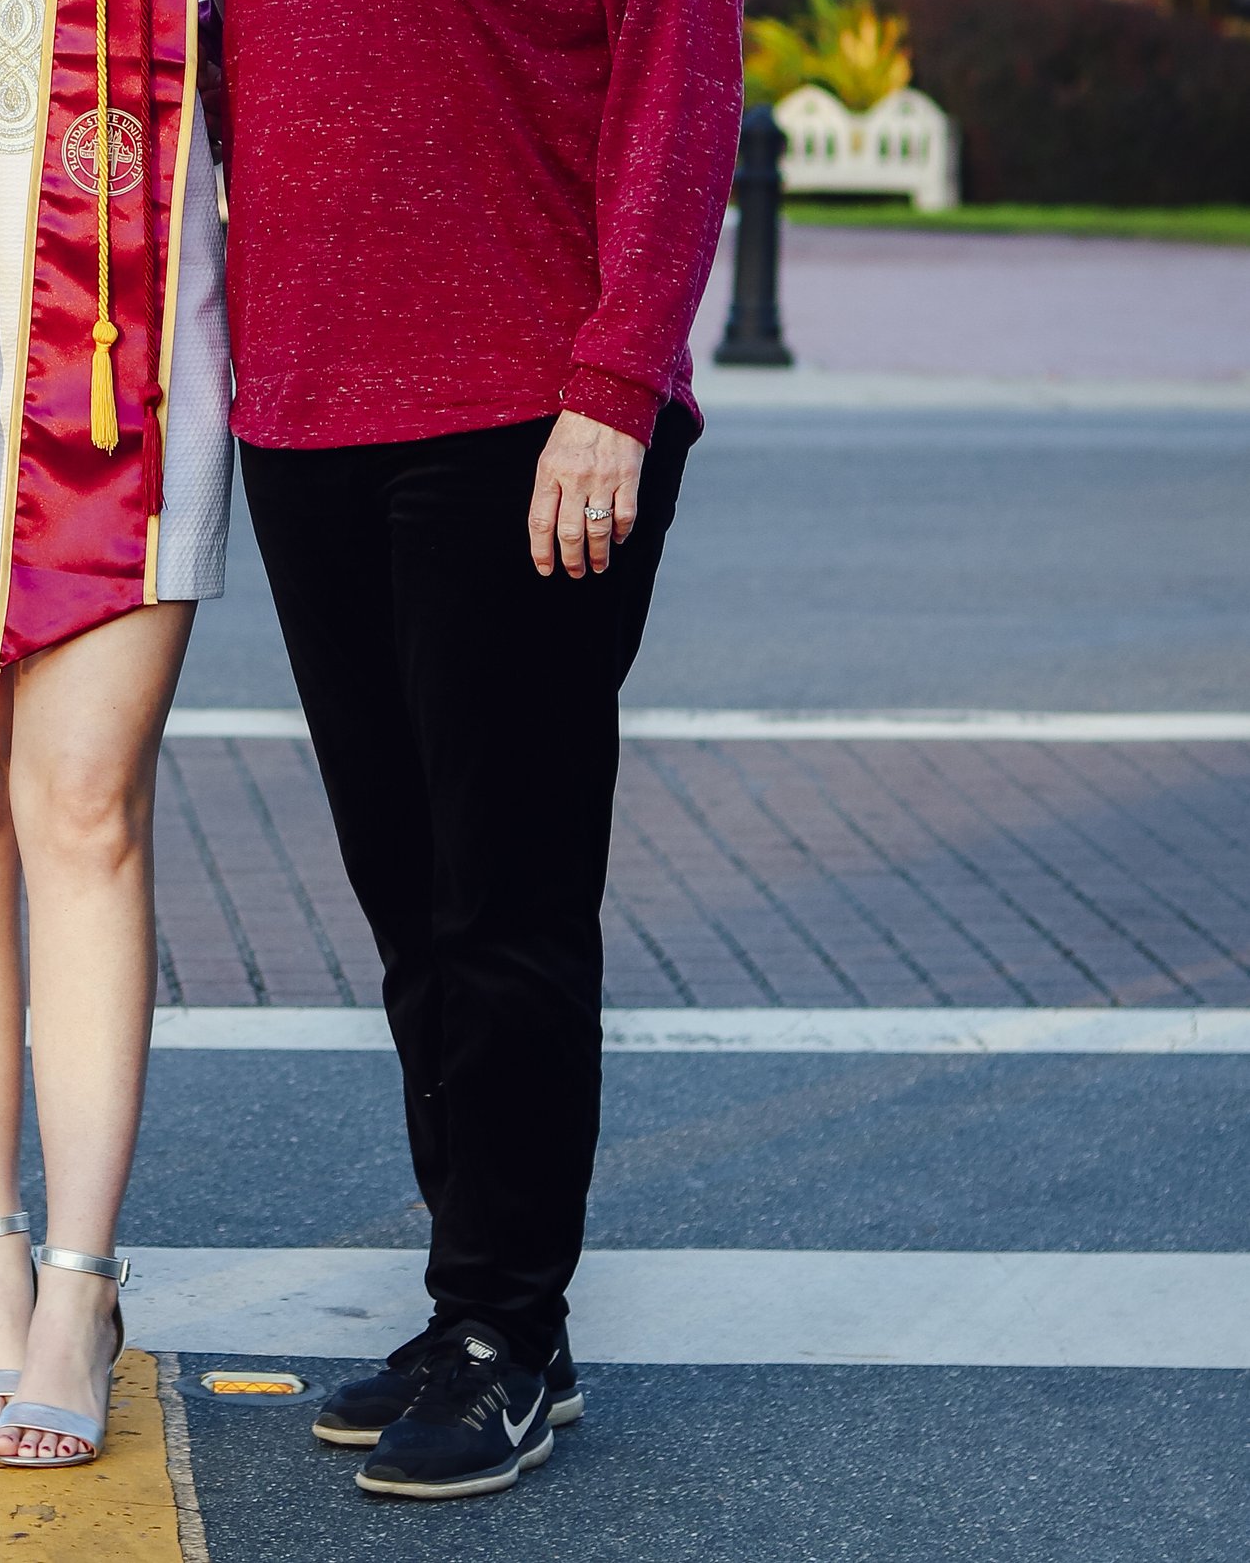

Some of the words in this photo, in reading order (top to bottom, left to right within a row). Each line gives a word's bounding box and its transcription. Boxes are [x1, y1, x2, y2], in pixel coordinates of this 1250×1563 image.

[67, 125, 88, 172] FLORIDA
[86, 113, 120, 127] STTE
[92, 181, 114, 191] 11
[466, 1342, 494, 1359] NIKE
